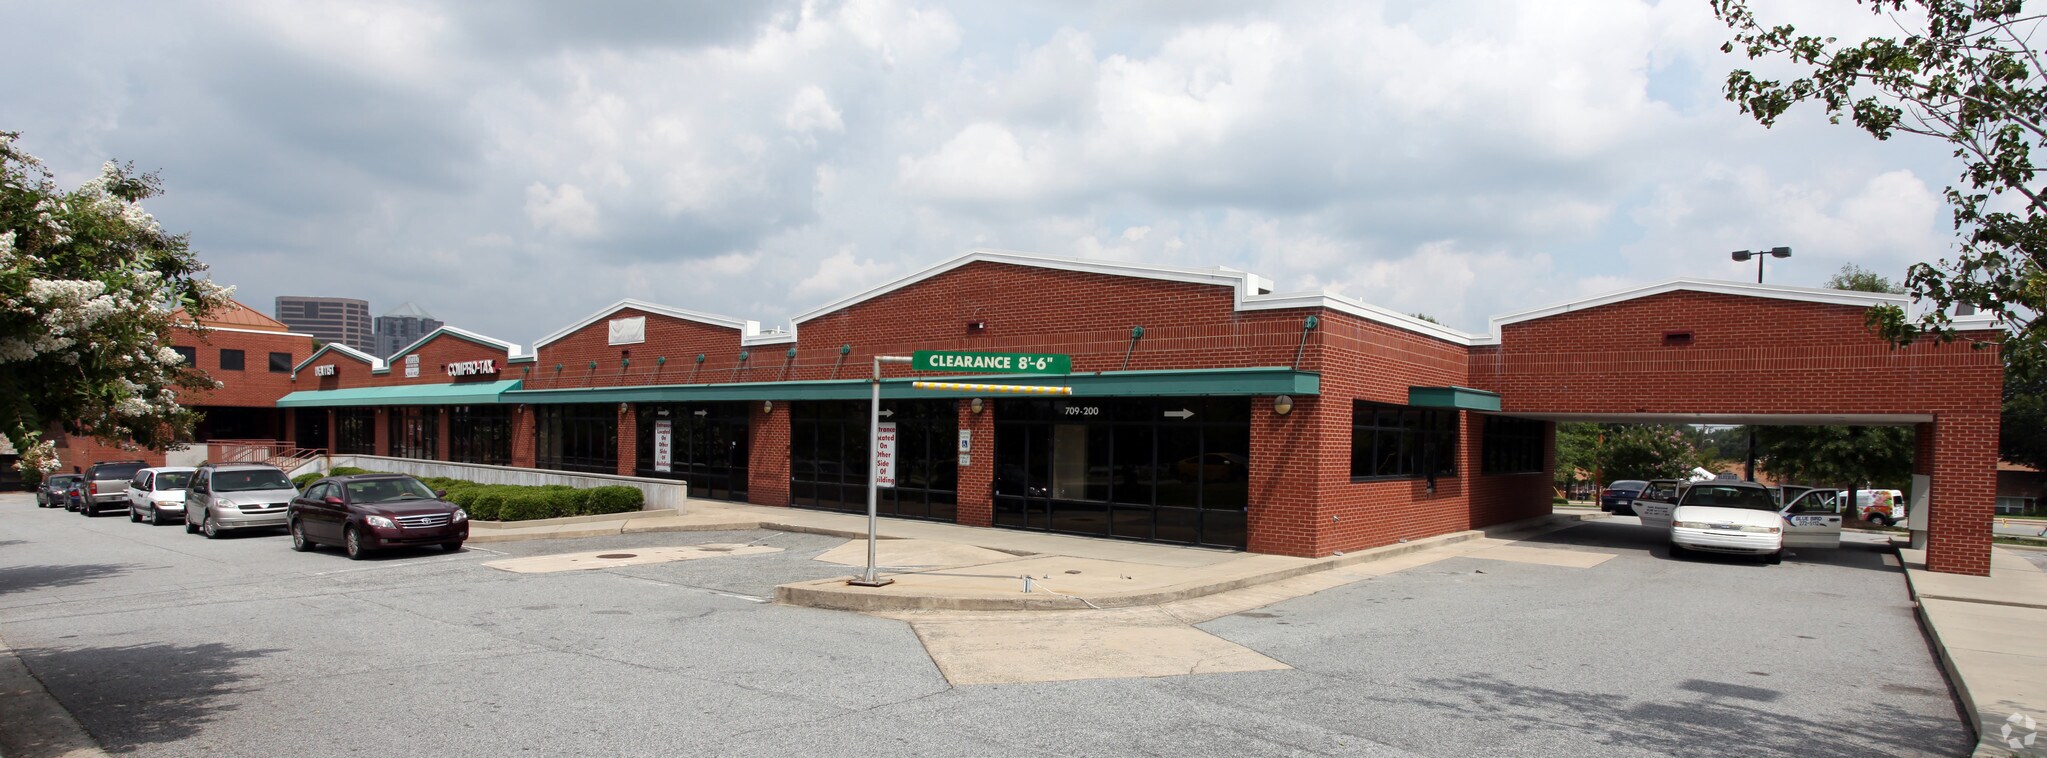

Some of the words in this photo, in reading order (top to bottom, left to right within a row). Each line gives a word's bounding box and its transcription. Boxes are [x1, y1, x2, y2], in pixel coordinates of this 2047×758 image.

[447, 359, 495, 377] COMPRO-TAX
[929, 354, 1011, 369] CLEARANCE
[1018, 356, 1053, 370] 8'-6"
[1065, 406, 1099, 416] 709-200
[877, 476, 895, 485] ilding
